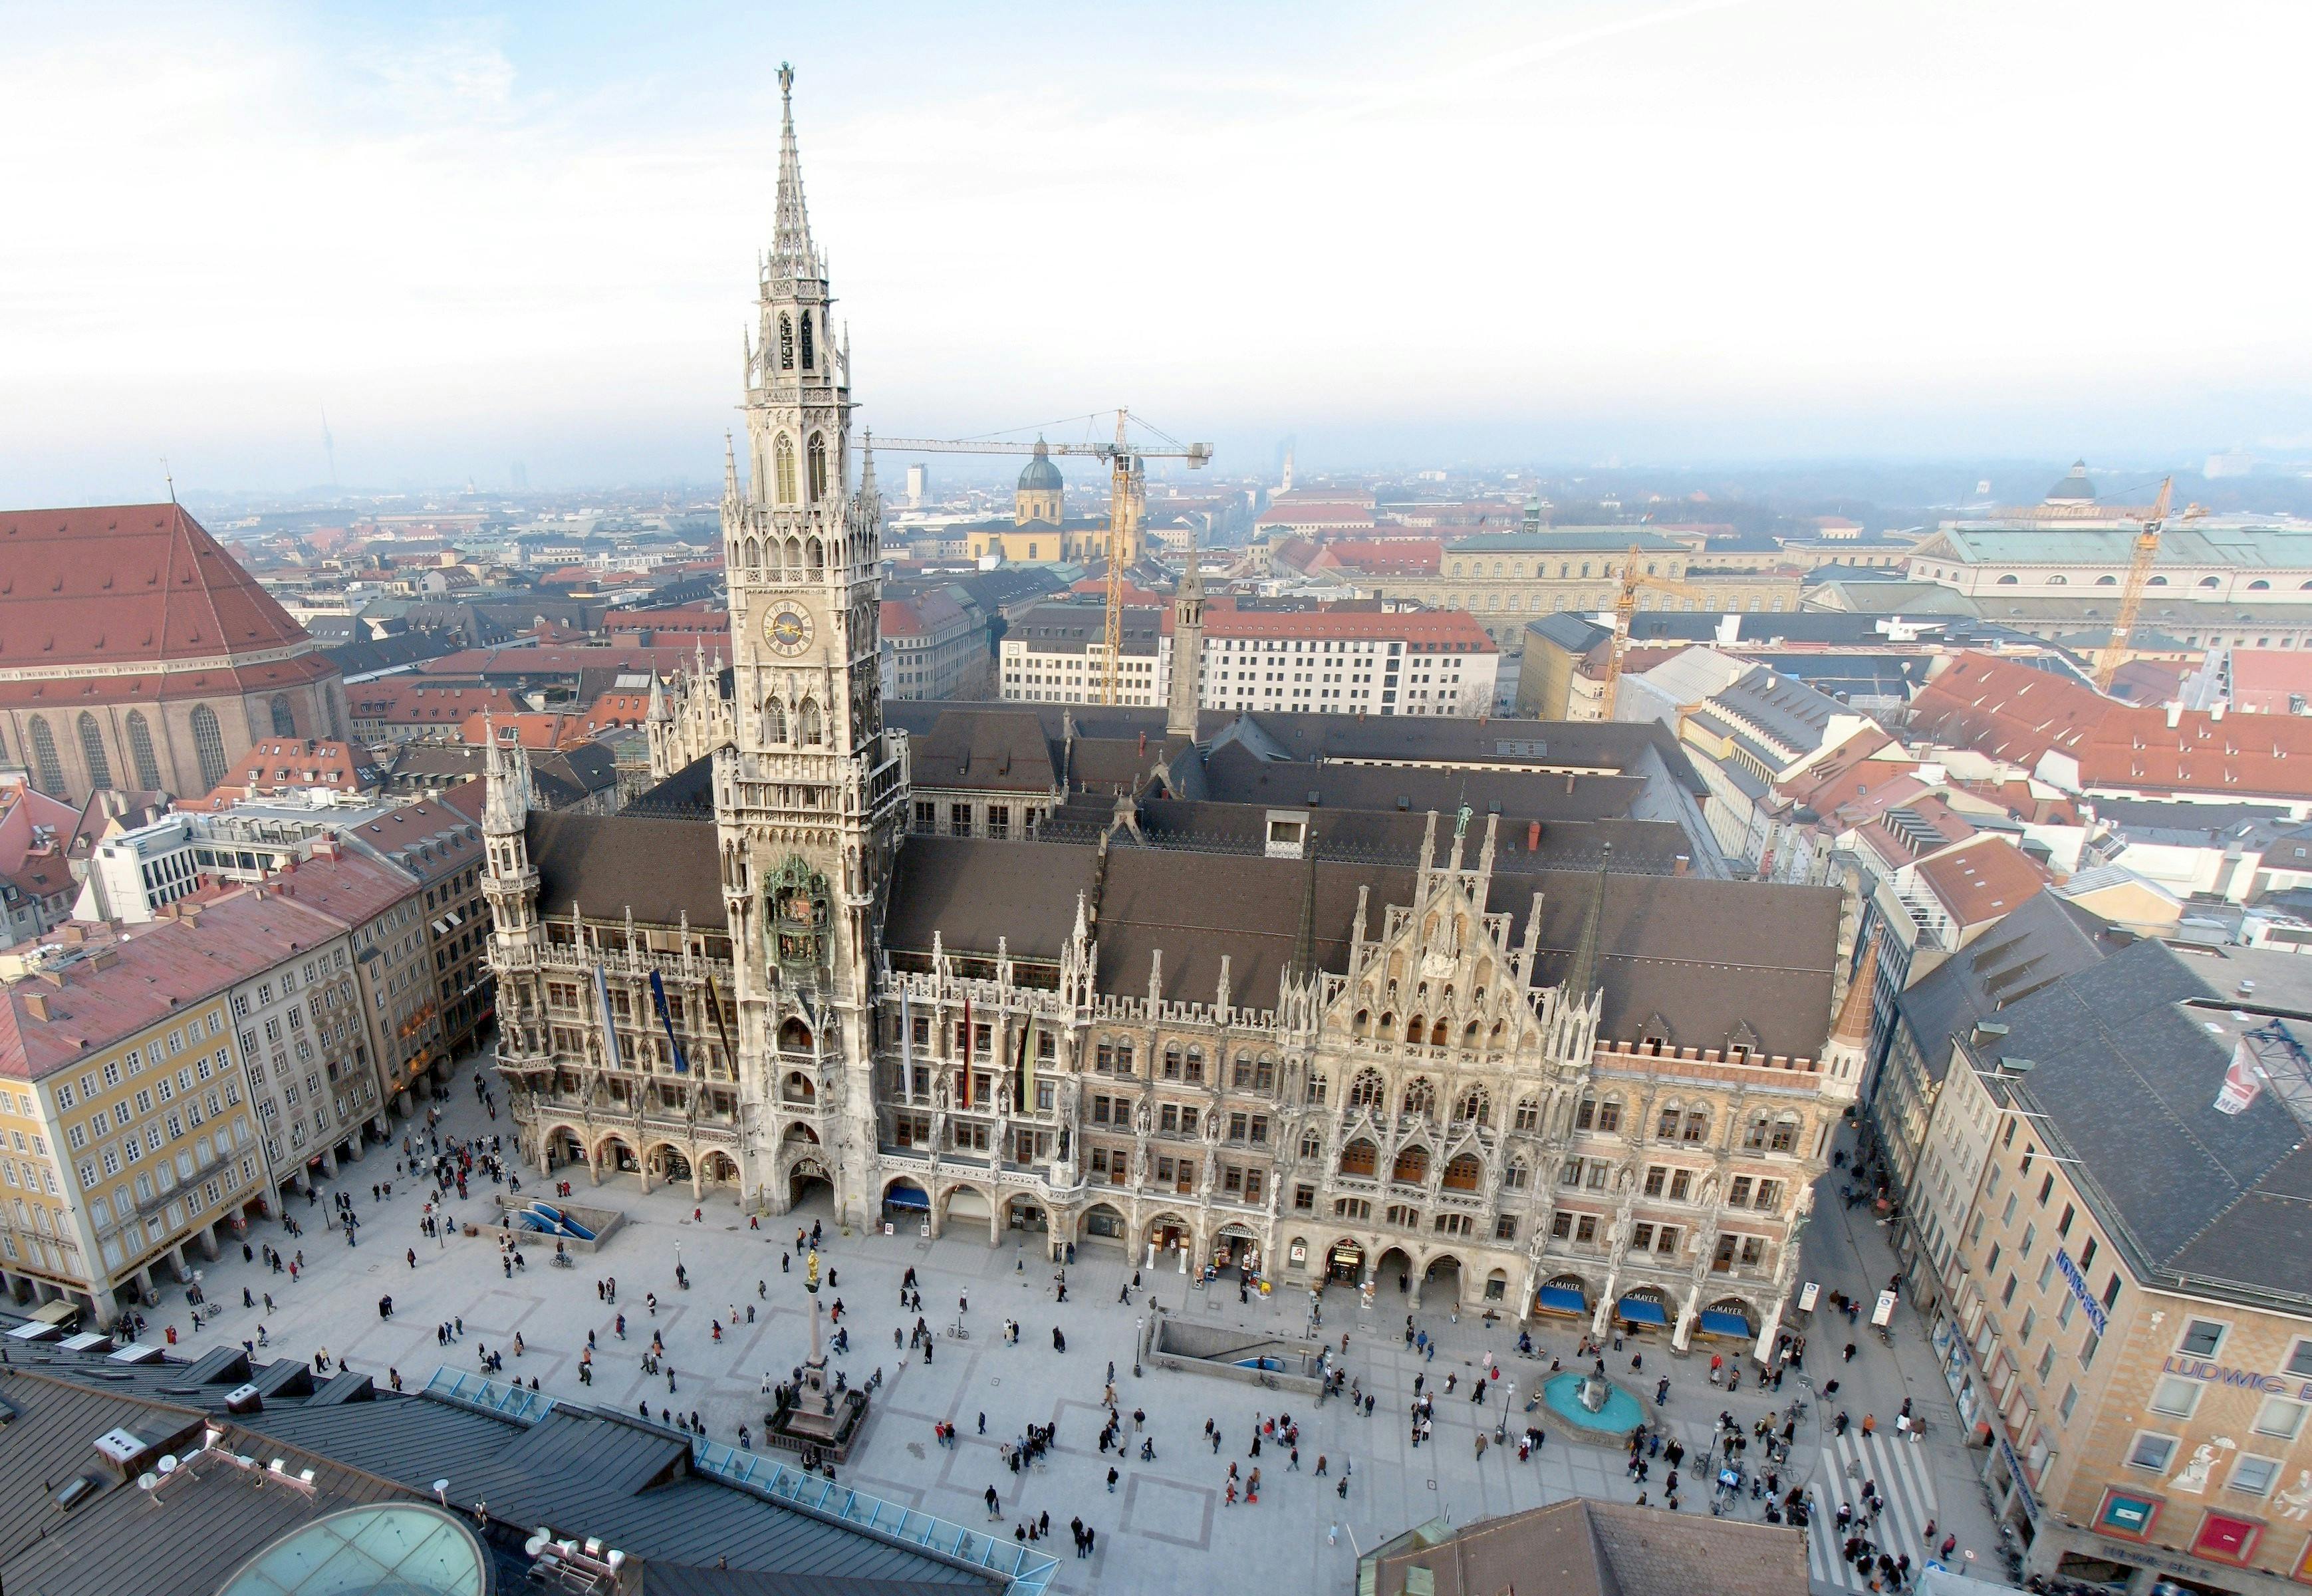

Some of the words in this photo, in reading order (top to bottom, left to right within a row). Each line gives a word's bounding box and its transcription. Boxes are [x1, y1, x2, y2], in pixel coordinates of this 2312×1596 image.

[1555, 1281, 1580, 1291] MAYER
[1633, 1293, 1658, 1303] MAYER
[1716, 1305, 1742, 1315] MAYER
[2163, 1356, 2286, 1393] LUDWIG
